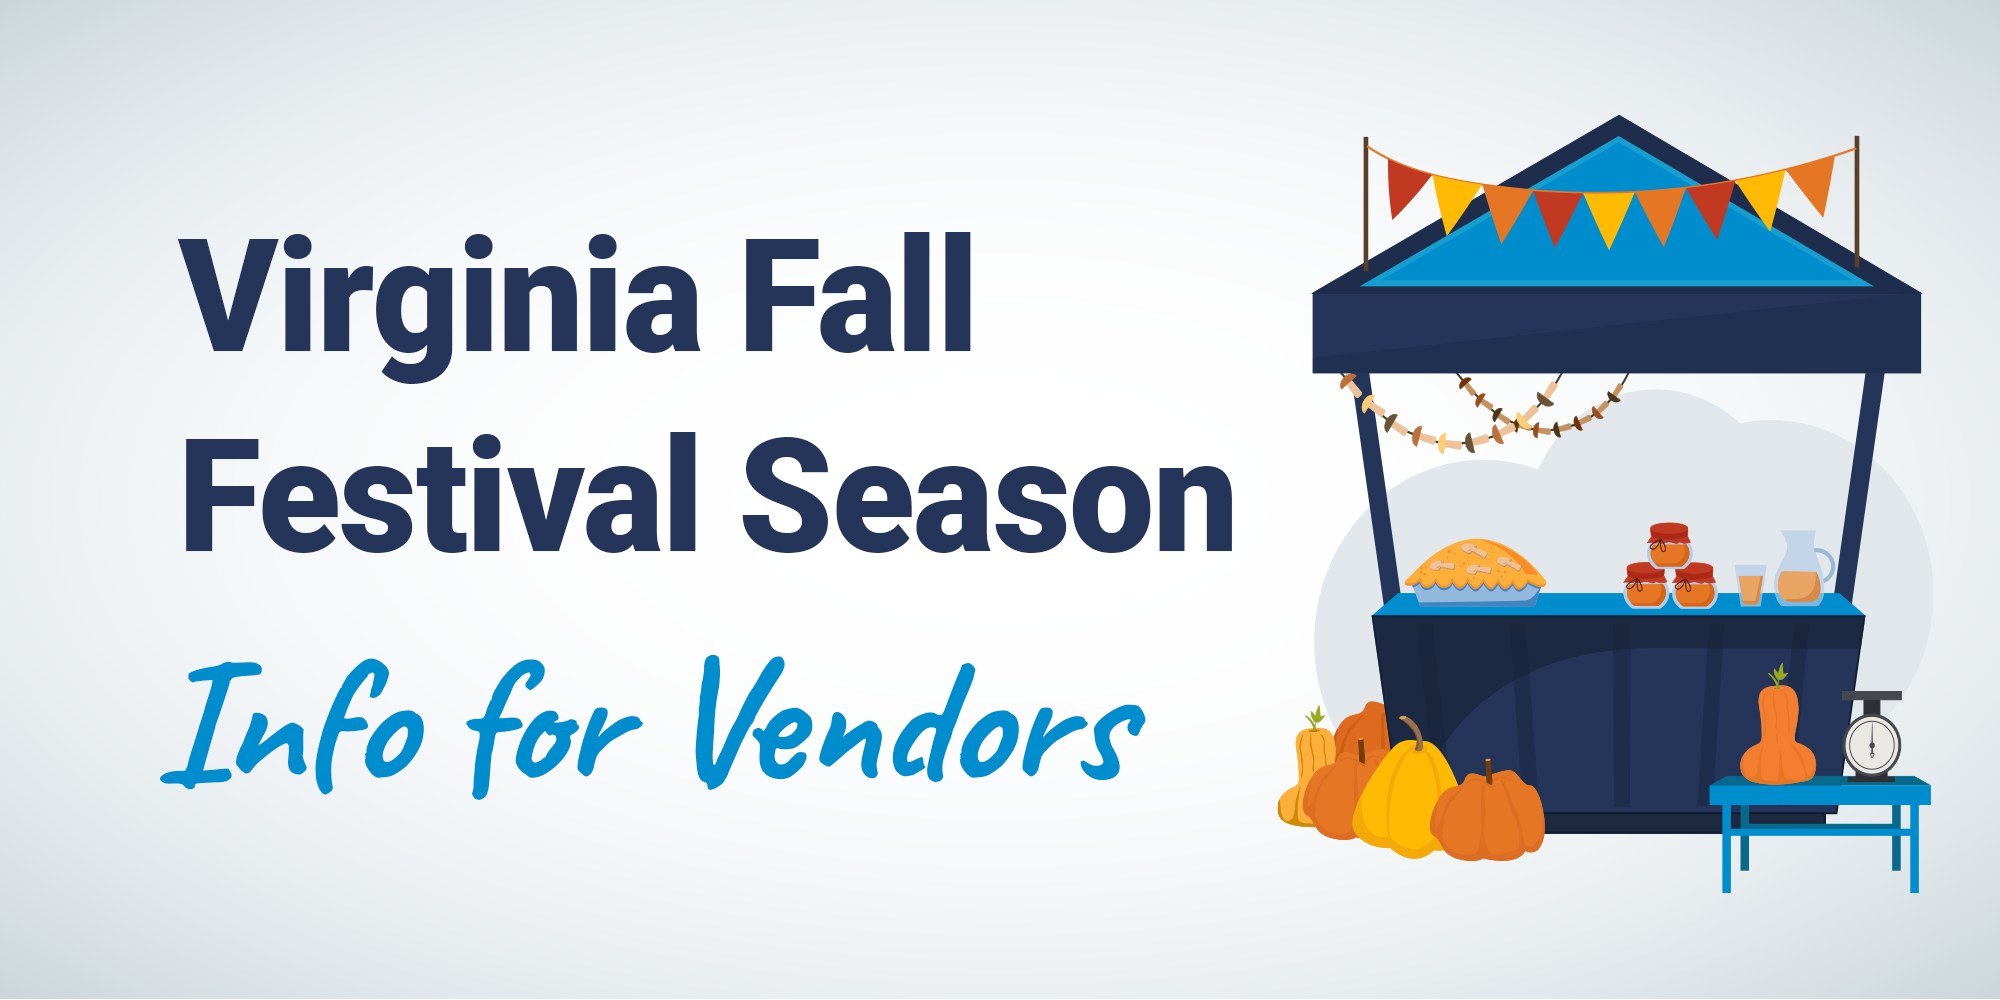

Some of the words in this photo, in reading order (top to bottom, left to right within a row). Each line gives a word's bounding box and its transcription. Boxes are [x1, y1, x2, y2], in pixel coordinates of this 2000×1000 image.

[177, 233, 701, 385] Virginia
[745, 231, 971, 352] Fall
[185, 431, 696, 554] Festival
[742, 436, 1233, 554] Season
[159, 658, 425, 796] Info
[465, 658, 644, 801] for
[695, 654, 1146, 791] Vendors
